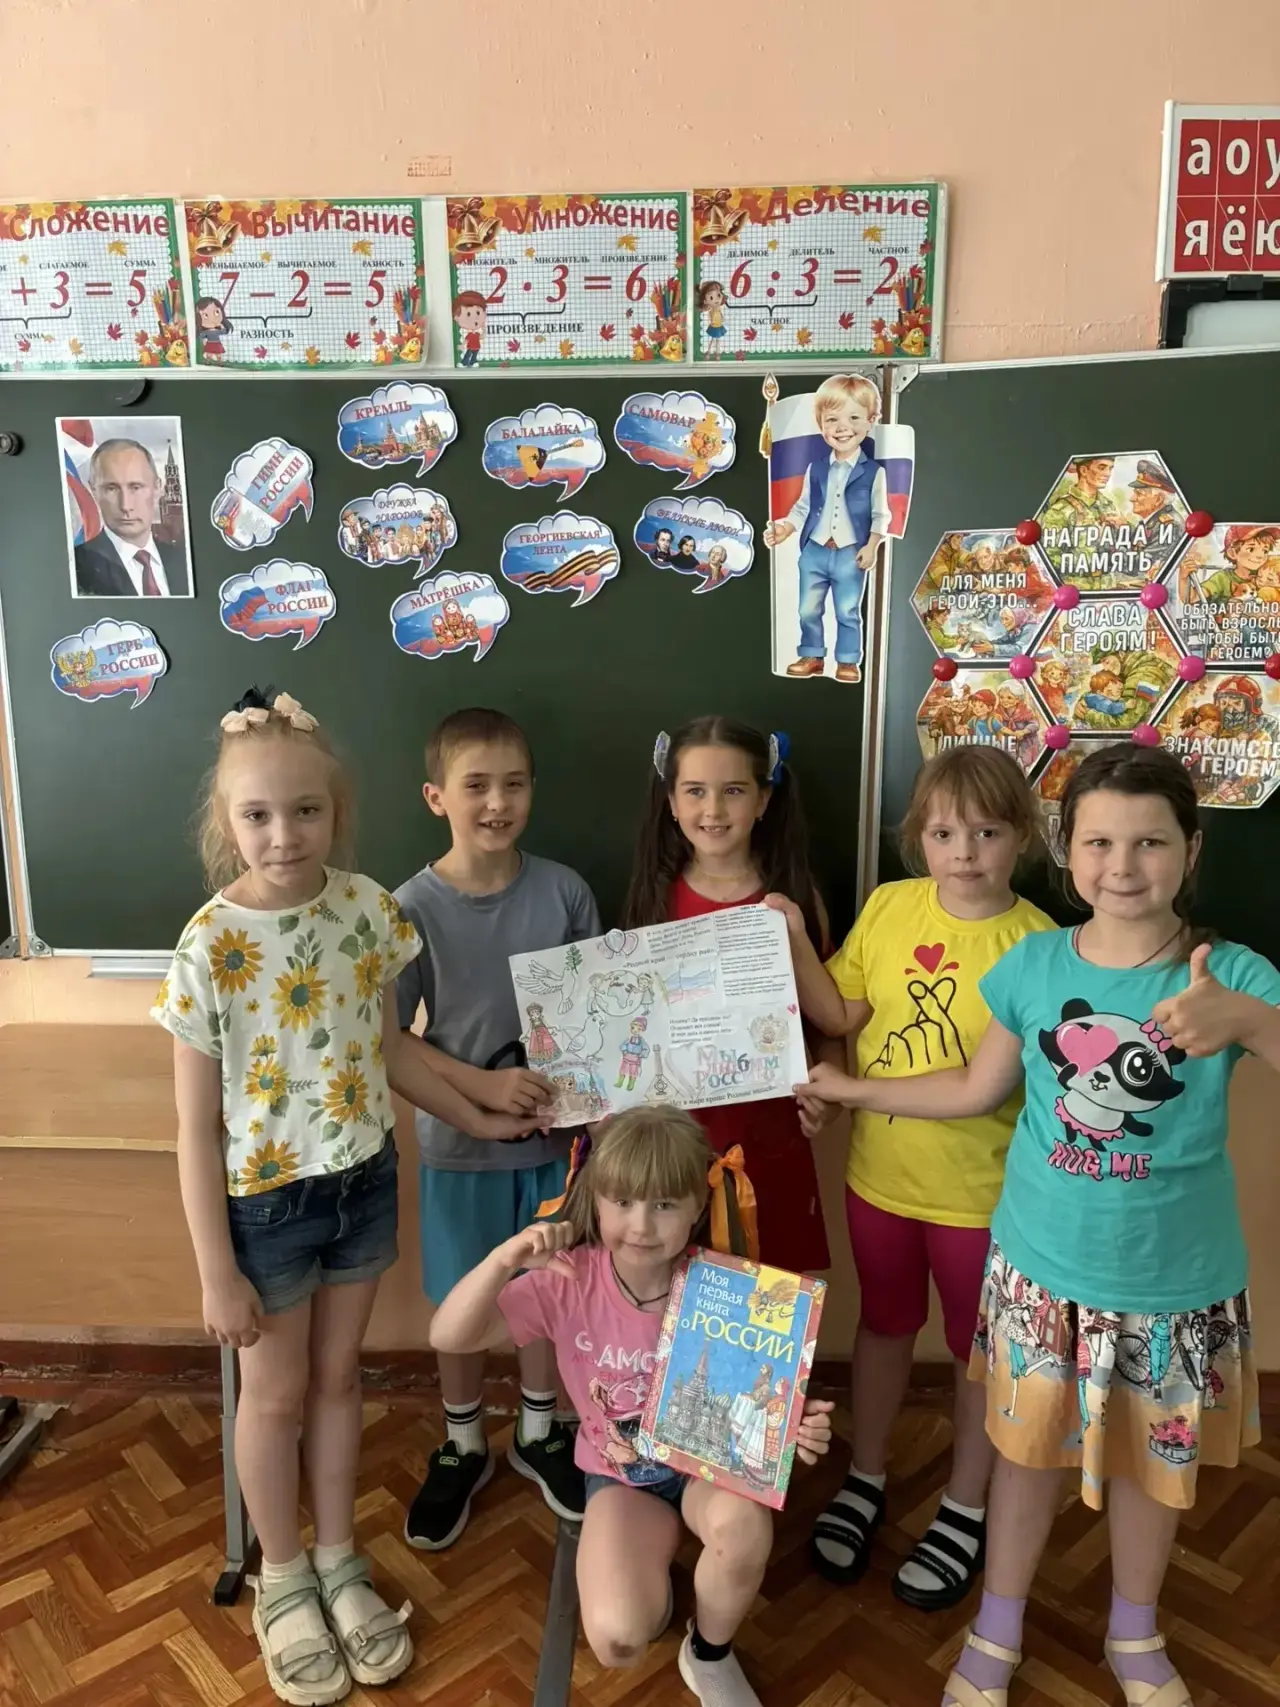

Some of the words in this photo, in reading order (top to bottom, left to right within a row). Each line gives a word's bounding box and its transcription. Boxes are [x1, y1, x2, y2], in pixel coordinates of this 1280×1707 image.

[1186, 138, 1211, 175] а
[1225, 138, 1250, 175] о
[764, 191, 931, 224] Деление
[9, 210, 170, 241] Сложение
[251, 208, 415, 239] Вычитание
[513, 204, 680, 234] Умножение
[1183, 219, 1209, 256] я
[1222, 205, 1247, 256] ё
[124, 259, 156, 267] СУММА
[534, 256, 590, 264] МНОЖИТЕЛЬ
[601, 254, 668, 263] ПРОИЗВЕДЕНИЕ
[727, 249, 769, 259] ДЕЛИМОЕ
[788, 247, 835, 257] ДЕЛИТЕЛЬ
[868, 246, 910, 255] ЧАСТНОЕ
[277, 260, 337, 269] ВЫЧИТАЕМОЕ
[362, 260, 405, 268] РАЗНОСТЬ
[485, 266, 508, 304] 2
[546, 264, 569, 303] 3
[625, 262, 649, 301] 6
[730, 259, 754, 299] 6
[794, 257, 819, 297] 3
[872, 256, 899, 295] 2
[50, 270, 70, 309] 3
[127, 269, 147, 307] 5
[219, 271, 240, 309] 7
[287, 269, 310, 308] 2
[364, 270, 387, 308] 5
[487, 322, 584, 335] ПРОИЗВЕДЕНИЕ
[750, 317, 791, 325] ЧАСТНОЕ
[240, 330, 294, 340] РАЗНОСТЬ
[355, 400, 412, 420] КРЕМЛЬ
[629, 404, 696, 429] САМОВАР
[501, 423, 582, 440] БАЛАЛАЙКА
[251, 450, 285, 490] ГИМН
[260, 455, 304, 509] РОССИИ
[519, 530, 600, 544] ГЕОРГИЕВСКАЯ
[1043, 525, 1147, 549] НАГРАДА
[1159, 523, 1173, 545] И
[533, 545, 567, 556] ЛЕНТА
[1060, 552, 1152, 573] ПАМЯТЬ
[275, 580, 313, 596] ФЛАГ
[940, 574, 973, 593] ДЛЯ
[981, 573, 1026, 589] МЕНЯ
[410, 580, 481, 609] МАТРЁШКА
[267, 596, 329, 615] РОССИИ
[1068, 604, 1142, 627] СЛАВА
[1183, 601, 1279, 615] ОБЯЗАТЕЛЬНО
[1181, 617, 1216, 630] БЫТЬ
[107, 638, 143, 656] ГЕРБ
[1060, 630, 1157, 653] ГЕРОЯМ!
[1198, 632, 1244, 645] ЧТОБЫ
[100, 653, 159, 676] РОССИИ
[1201, 756, 1276, 776] ГЕРОЕМ
[1047, 1138, 1104, 1181] HUG
[1110, 1151, 1153, 1182] ME
[701, 1267, 731, 1288] Моя
[699, 1282, 744, 1306] первая
[696, 1298, 730, 1317] книга
[690, 1310, 795, 1363] РОССИИ
